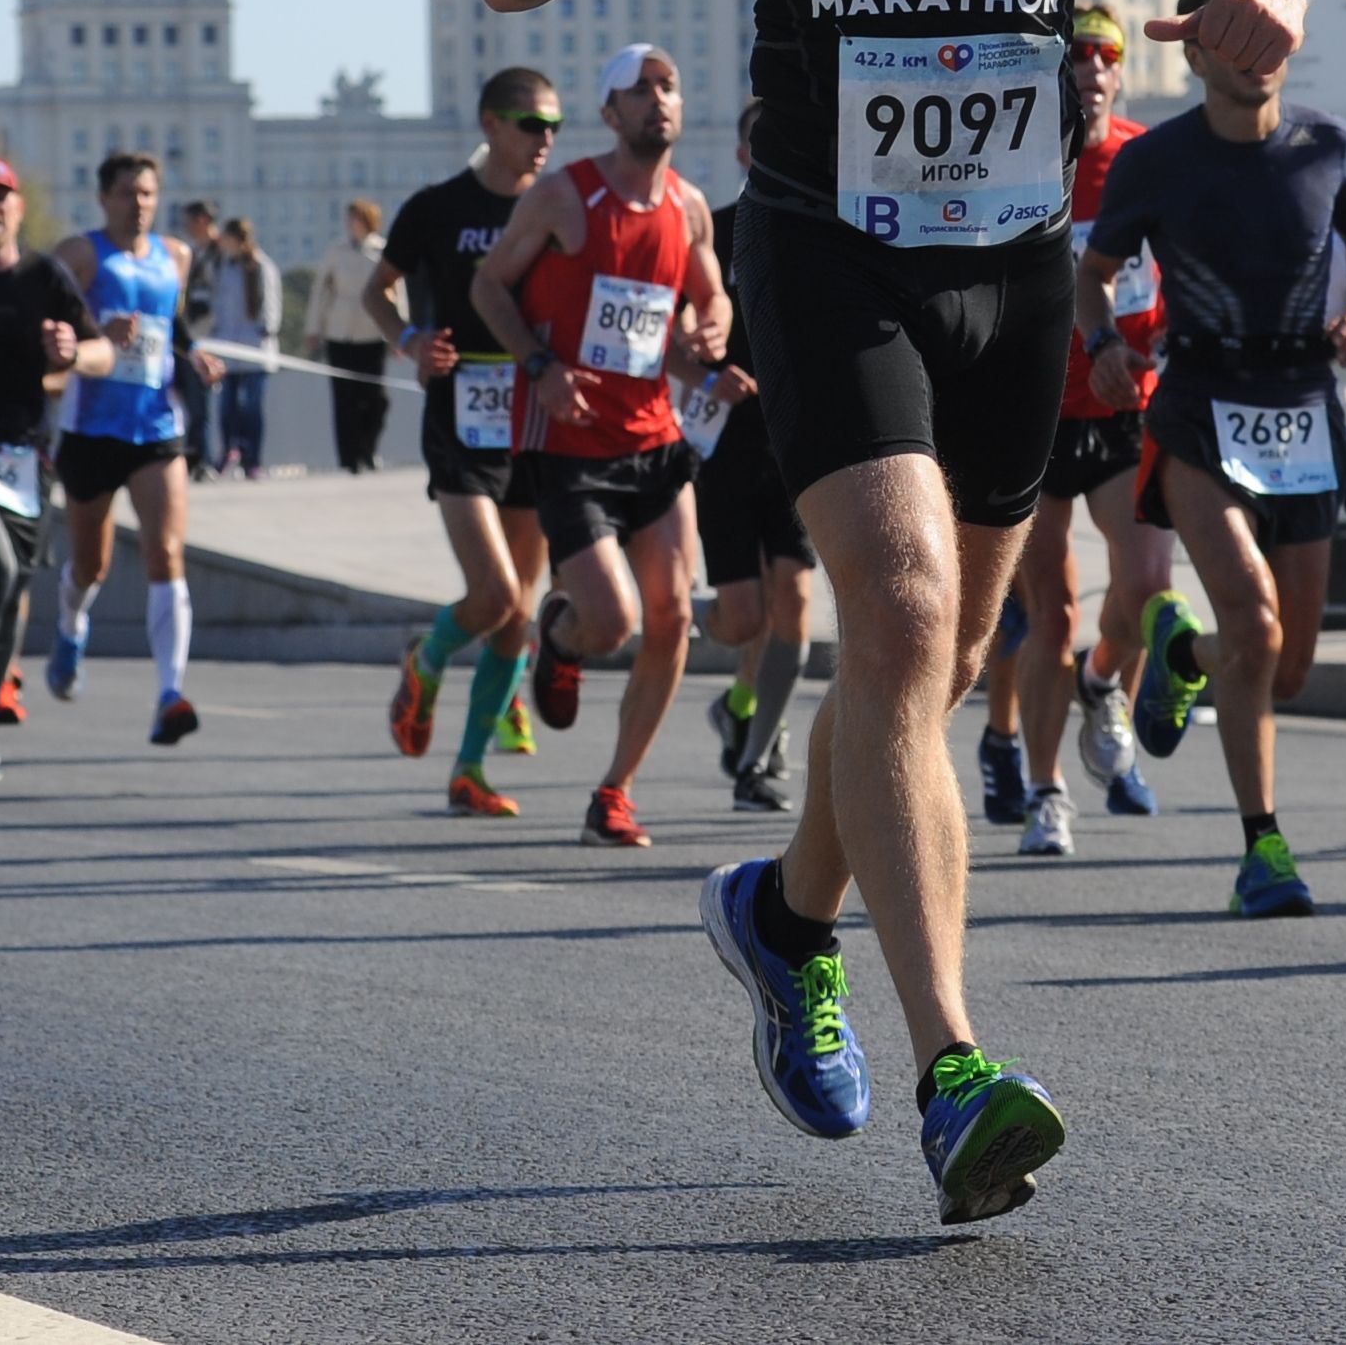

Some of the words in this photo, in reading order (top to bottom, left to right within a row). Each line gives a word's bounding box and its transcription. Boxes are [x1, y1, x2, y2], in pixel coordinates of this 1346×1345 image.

[854, 51, 896, 69] 42,2
[865, 86, 1037, 159] 9097
[921, 162, 990, 183] ИГОРЬ
[1226, 410, 1314, 446] 2689
